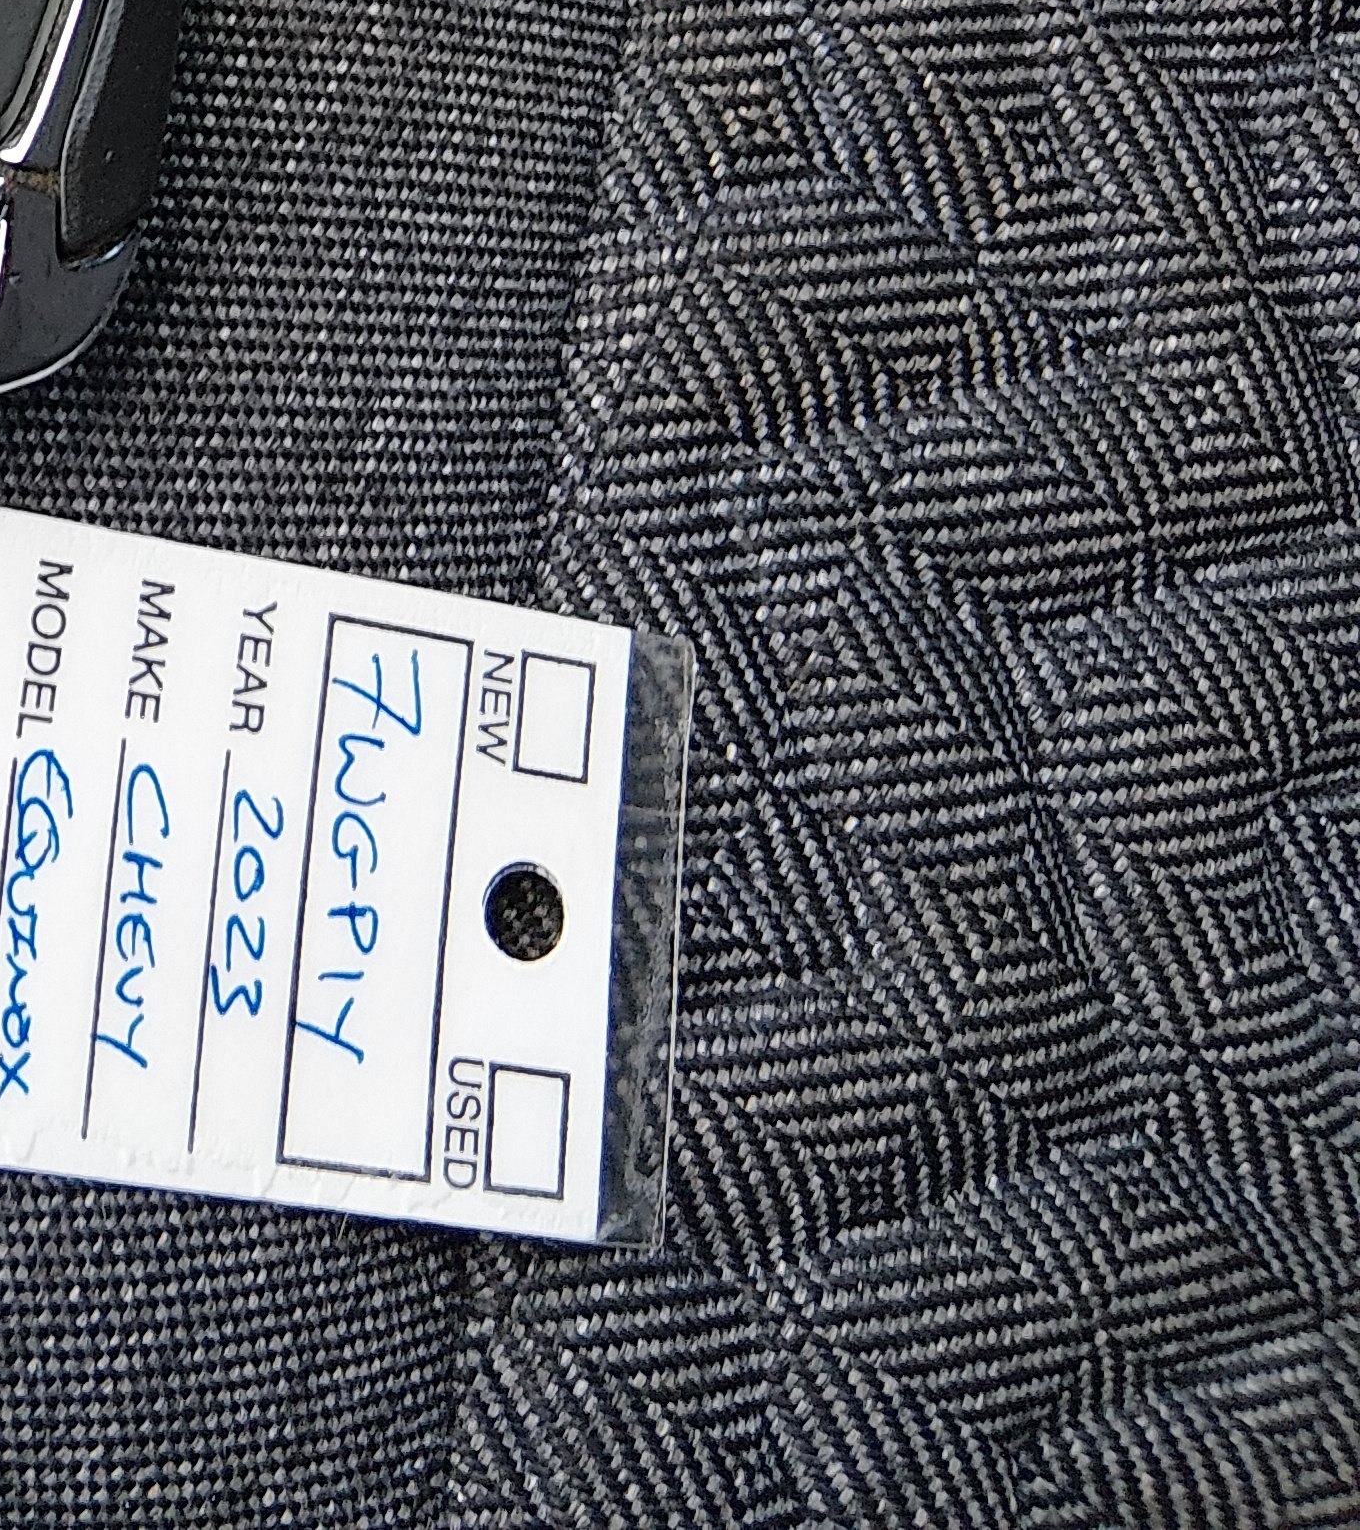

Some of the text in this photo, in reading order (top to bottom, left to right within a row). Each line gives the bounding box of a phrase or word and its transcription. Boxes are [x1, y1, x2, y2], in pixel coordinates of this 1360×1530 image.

[16, 559, 74, 740] MODEL
[476, 650, 515, 766] NEW
[91, 578, 176, 1070] MAKE CHEVY
[206, 601, 285, 1018] YEAR 2023
[442, 1057, 485, 1189] USED
